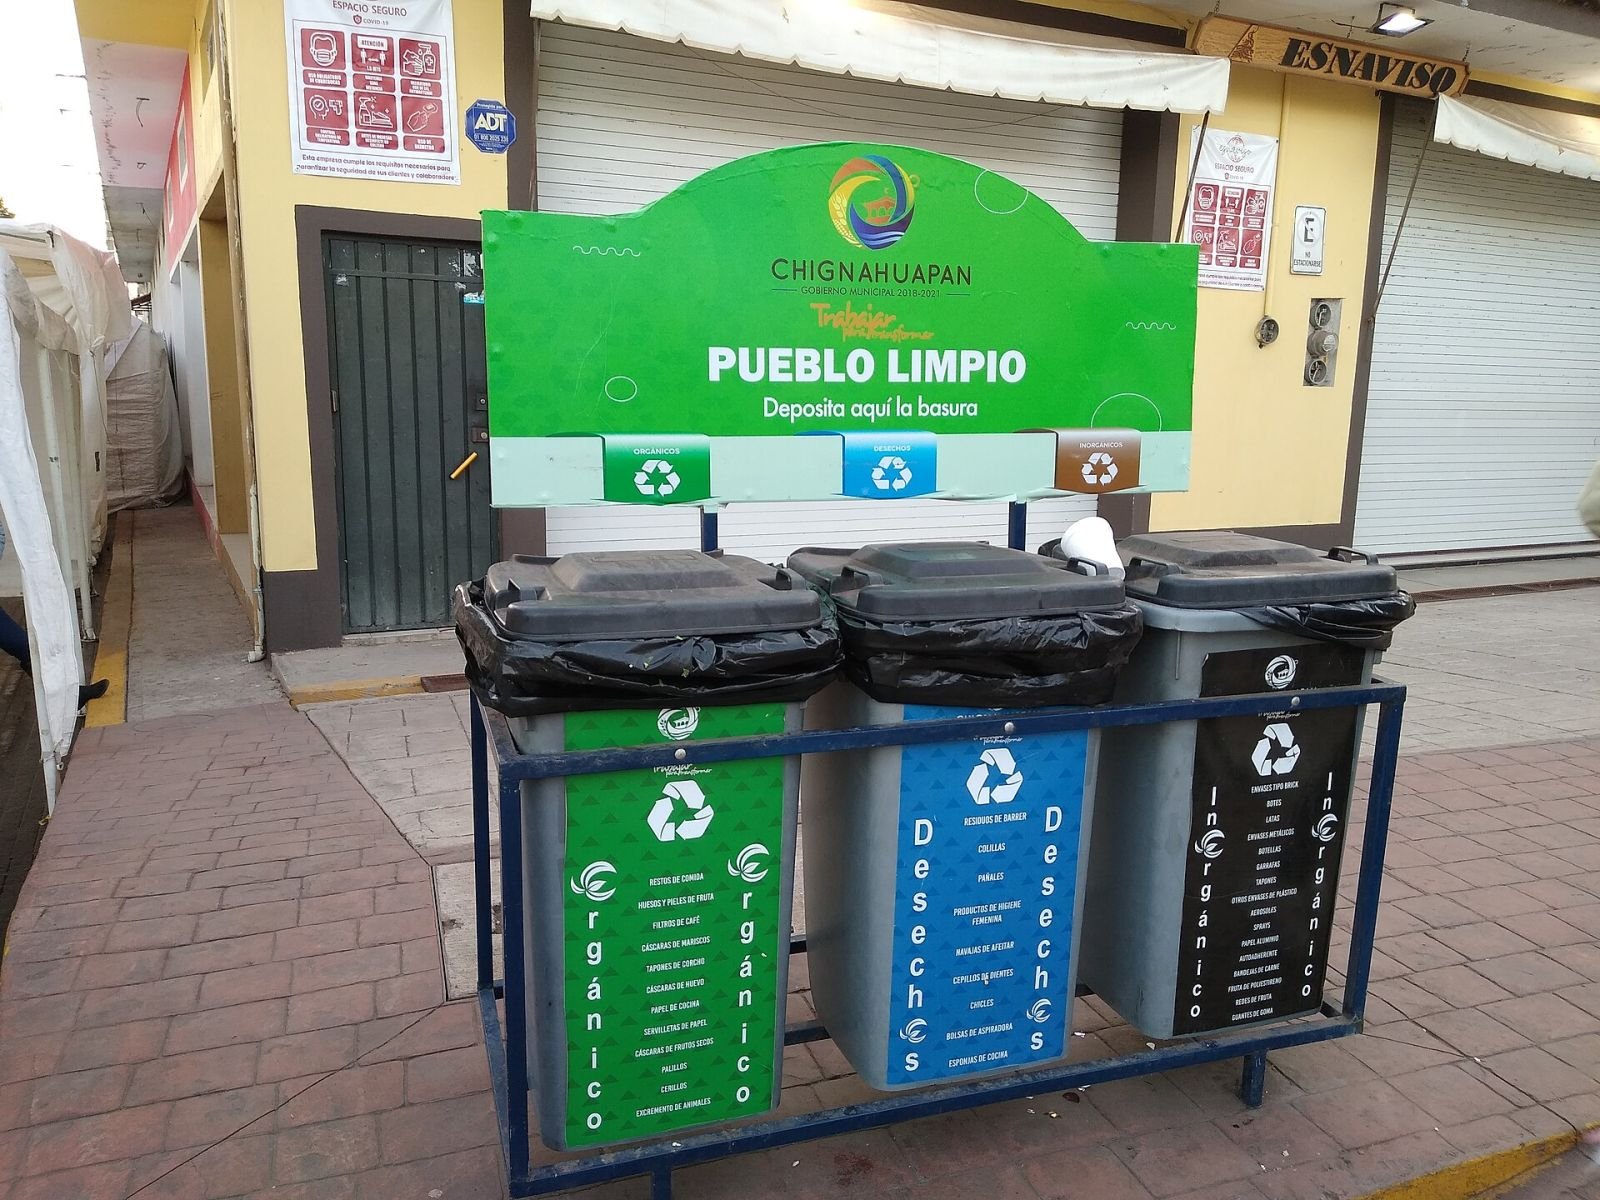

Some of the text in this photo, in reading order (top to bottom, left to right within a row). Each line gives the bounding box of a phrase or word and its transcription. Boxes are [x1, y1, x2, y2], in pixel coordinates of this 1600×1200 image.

[332, 1, 407, 17] ESPACIO SEGURO
[1278, 37, 1457, 95] ESNAVISO
[474, 112, 508, 132] ADT
[302, 154, 316, 162] Esta
[316, 157, 343, 165] empresa
[343, 159, 366, 167] cumple
[376, 161, 404, 170] requisitos
[336, 166, 367, 176] seguridad
[388, 170, 411, 178] clientes
[1234, 165, 1255, 174] SEGURO
[771, 258, 972, 287] CHIGNAHUAPAN
[801, 286, 941, 298] GOBIERNO MUNICIPAL 2018-2021
[809, 300, 897, 332] Trabajar
[708, 346, 1027, 383] PUEBLO LIMPIO
[763, 396, 978, 423] Deposita aquí la basura
[633, 446, 681, 456] ORGÁNICOS
[873, 444, 912, 453] DESECHOS
[1078, 441, 1124, 450] INORGÁNICOS
[1251, 781, 1299, 794] ENVASES TIPO BRICK
[1266, 799, 1282, 808] BOTES
[964, 812, 1027, 826] RESIDUOS DE BARRER
[1265, 815, 1280, 824] LATAS
[1247, 828, 1295, 841] ENVASES METÁLICOS
[978, 843, 1006, 854] COLILLAS
[1258, 845, 1281, 855] BOTELLAS
[1256, 860, 1280, 870] GARRAFAS
[649, 872, 704, 886] RESTOS DE COMIDA
[977, 872, 1004, 883] PAÑALES
[1255, 876, 1277, 886] TAPONES
[638, 892, 714, 909] HUESOS Y PIELES DE FRUTA
[1231, 896, 1248, 904] OTROS
[1248, 892, 1269, 902] ENVASES
[1276, 887, 1298, 898] PLÁSTICO
[953, 900, 1022, 916] PRODUCTOS DE HIGIENE
[1250, 906, 1277, 916] AEROSOLES
[653, 915, 700, 929] FILTROS DE CAFÉ
[972, 914, 1003, 926] FEMENINA
[1253, 922, 1271, 931] SPRAYS
[641, 936, 711, 952] CÁSCARAS DE MARISCOS
[1241, 934, 1279, 947] PAPEL ALUMINIO
[955, 941, 1015, 957] NAVAJAS DE AFEITAR
[1239, 950, 1278, 962] AUTOADHERENTE
[646, 957, 705, 973] TAPONES DE CORCHO
[1233, 963, 1280, 978] BANDEJAS DE CARNE
[953, 974, 980, 985] CEPILLOS
[990, 968, 1014, 980] DIENTES
[646, 978, 705, 994] CÁSCARAS DE HUEVO
[1228, 977, 1282, 993] FRUTA DE POLIESTIRENO
[970, 999, 994, 1010] CHICLES
[1235, 993, 1272, 1006] REDES DE FRUTA
[651, 1000, 700, 1014] PAPEL DE COCINA
[1231, 1007, 1273, 1021] GUANTES DE GOMA
[643, 1019, 707, 1036] SERVILLETAS DE PAPEL
[946, 1022, 1013, 1041] BOLSAS DE ASPIRADORA
[635, 1038, 714, 1058] CÁSCARAS DE FRUTOS SECOS
[948, 1050, 1008, 1068] ESPONJAS DE COCINA
[662, 1062, 687, 1073] PALILLOS
[661, 1082, 687, 1093] CERILLOS
[636, 1098, 711, 1117] EXCREMENTO DE ANIMALES
